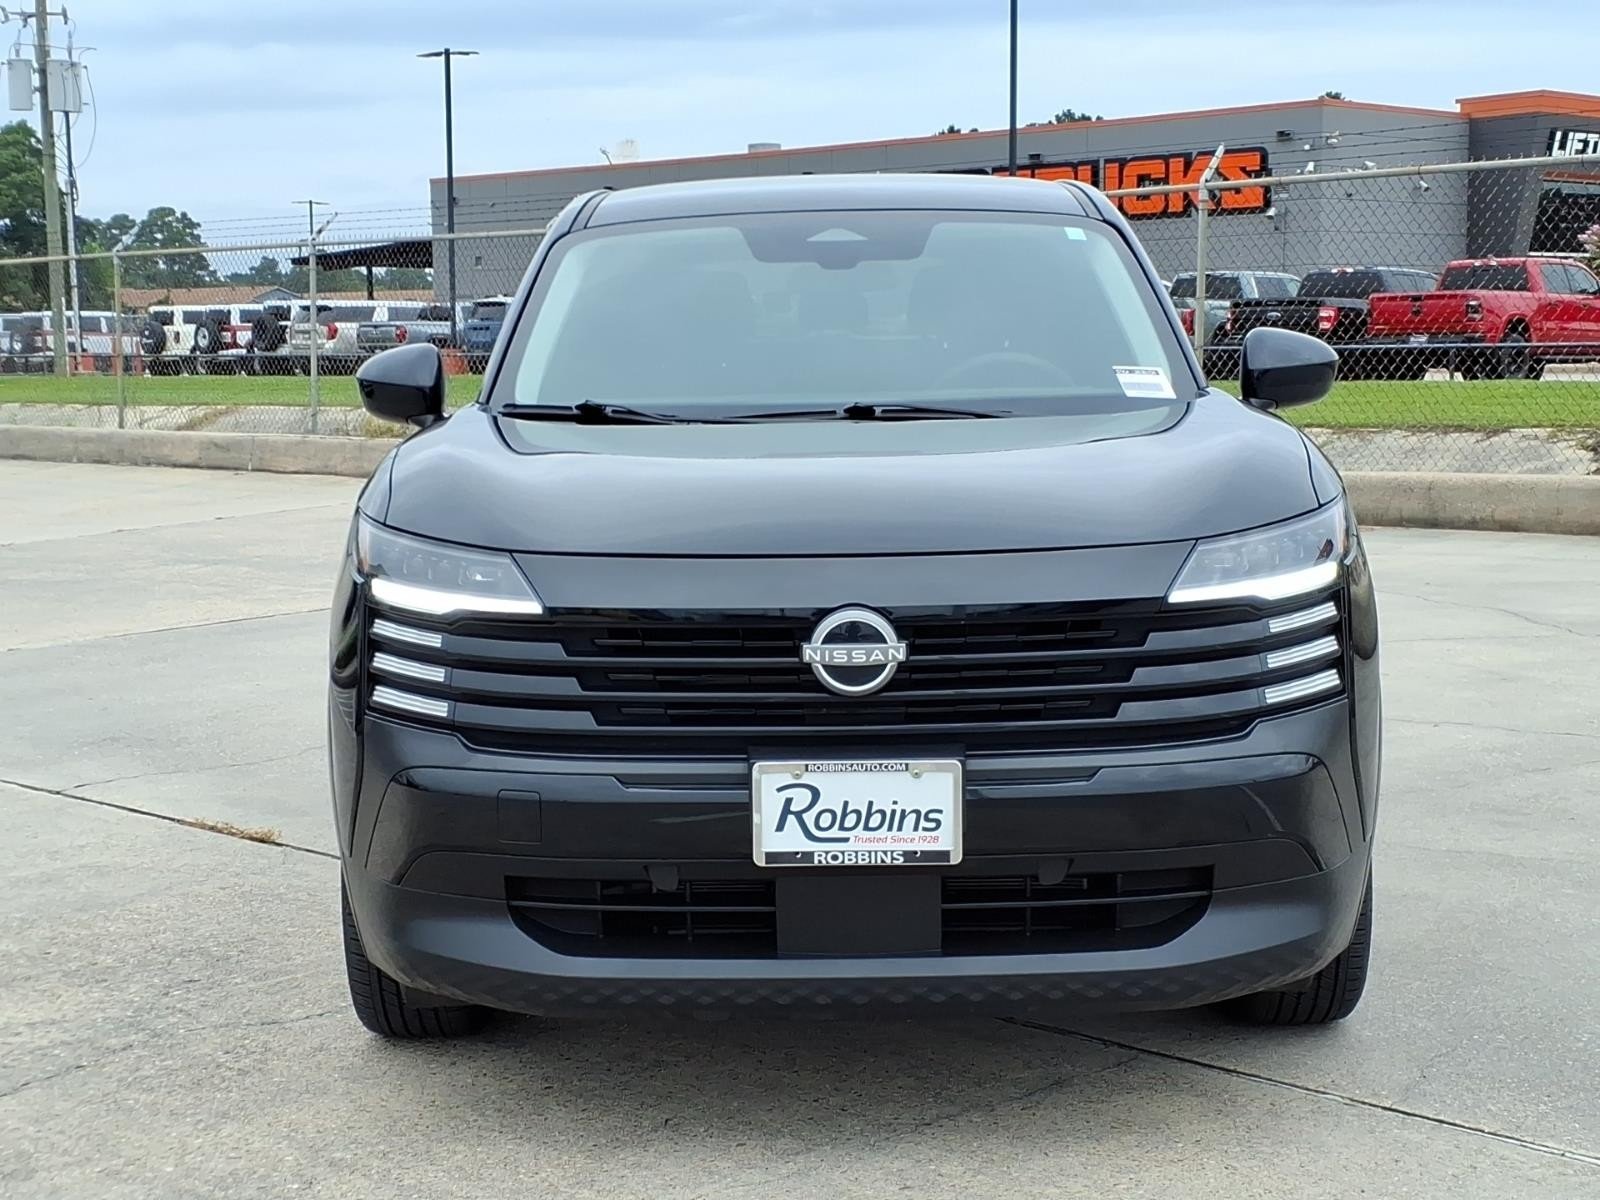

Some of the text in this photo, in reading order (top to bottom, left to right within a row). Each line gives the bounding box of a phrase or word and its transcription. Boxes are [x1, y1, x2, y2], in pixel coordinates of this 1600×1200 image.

[1551, 131, 1600, 157] LIFT
[805, 647, 904, 662] NISSAN
[807, 763, 906, 773] ROBBINSAUTO.COM
[774, 783, 944, 843] Robbins
[853, 835, 940, 844] Trusted Since 1928
[813, 850, 905, 864] ROBBINS
